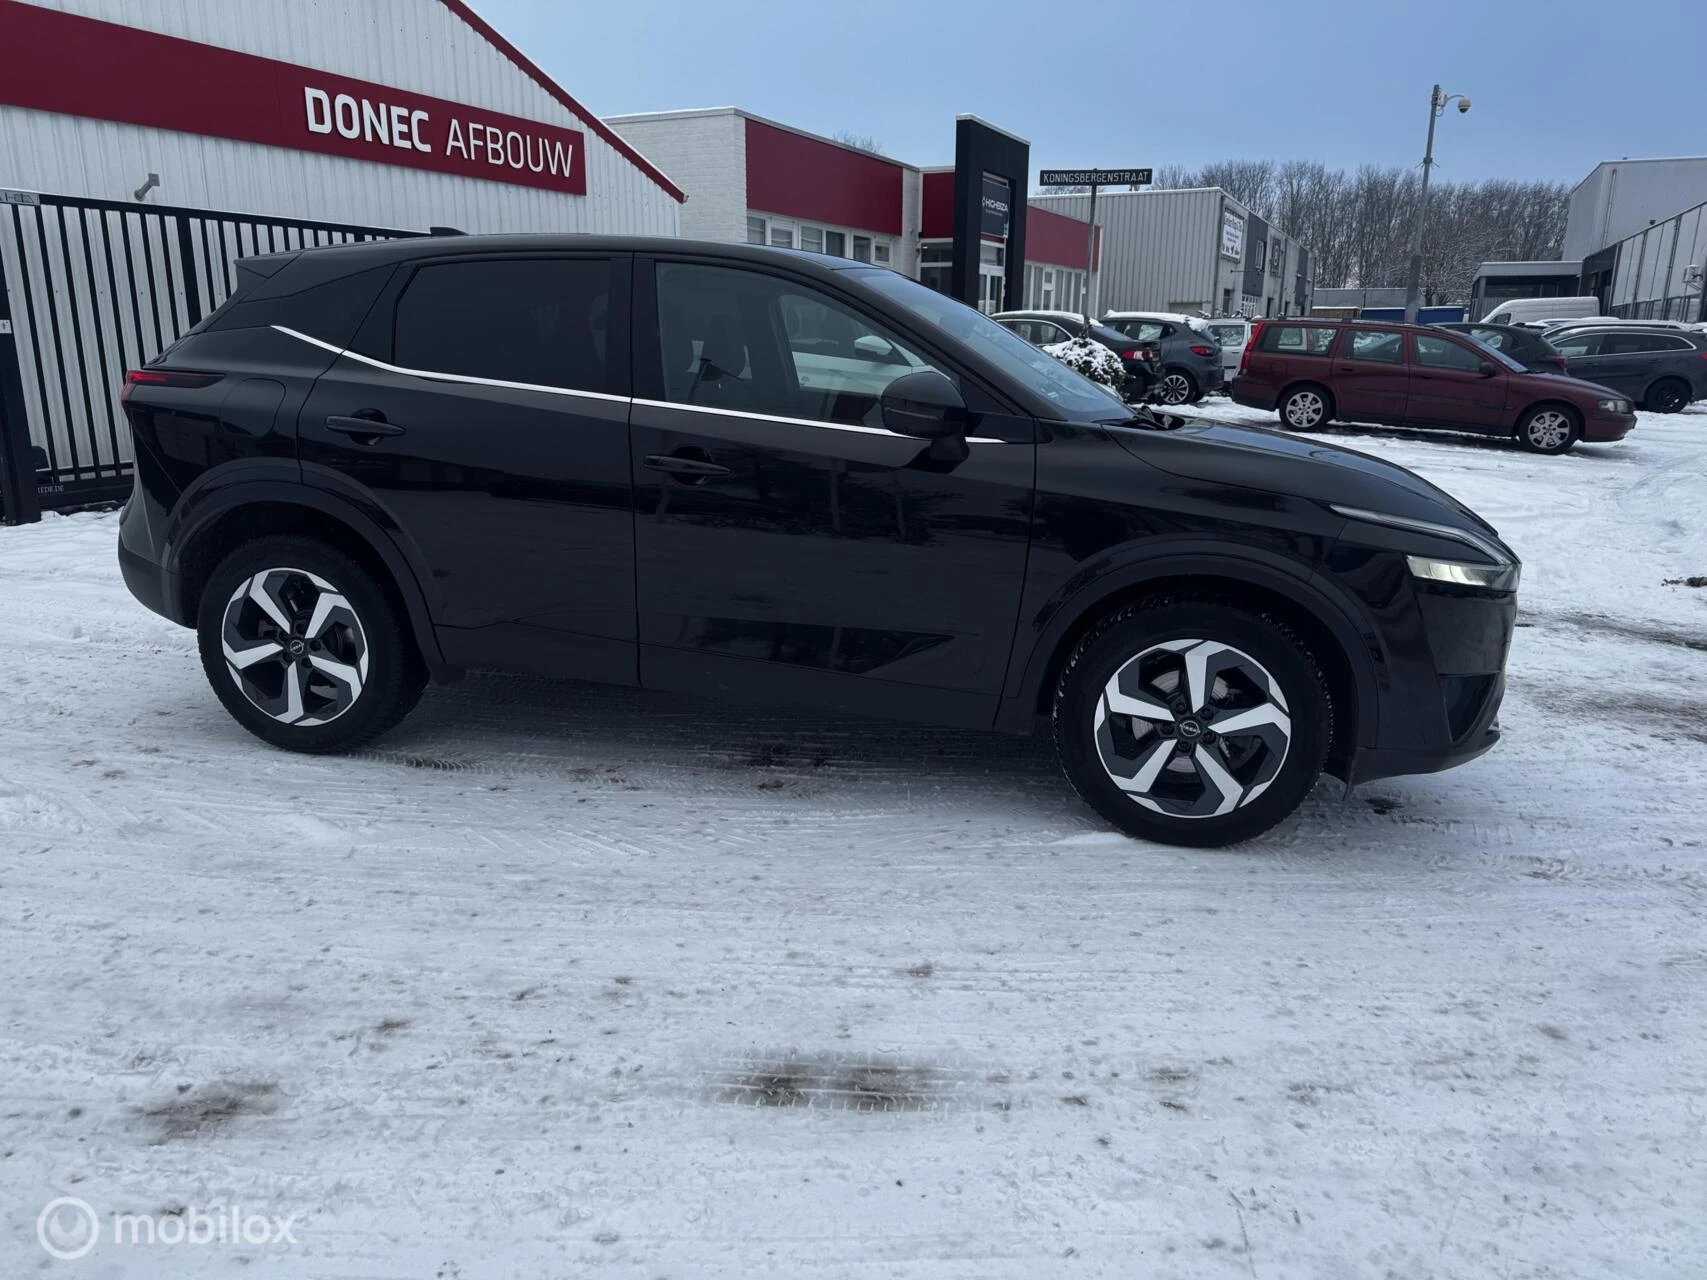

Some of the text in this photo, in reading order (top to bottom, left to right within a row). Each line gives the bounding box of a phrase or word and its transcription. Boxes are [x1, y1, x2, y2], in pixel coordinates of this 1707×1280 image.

[304, 86, 574, 178] DONEC AFBOUW
[1043, 171, 1149, 183] KONINGSBERGENSTRAAT
